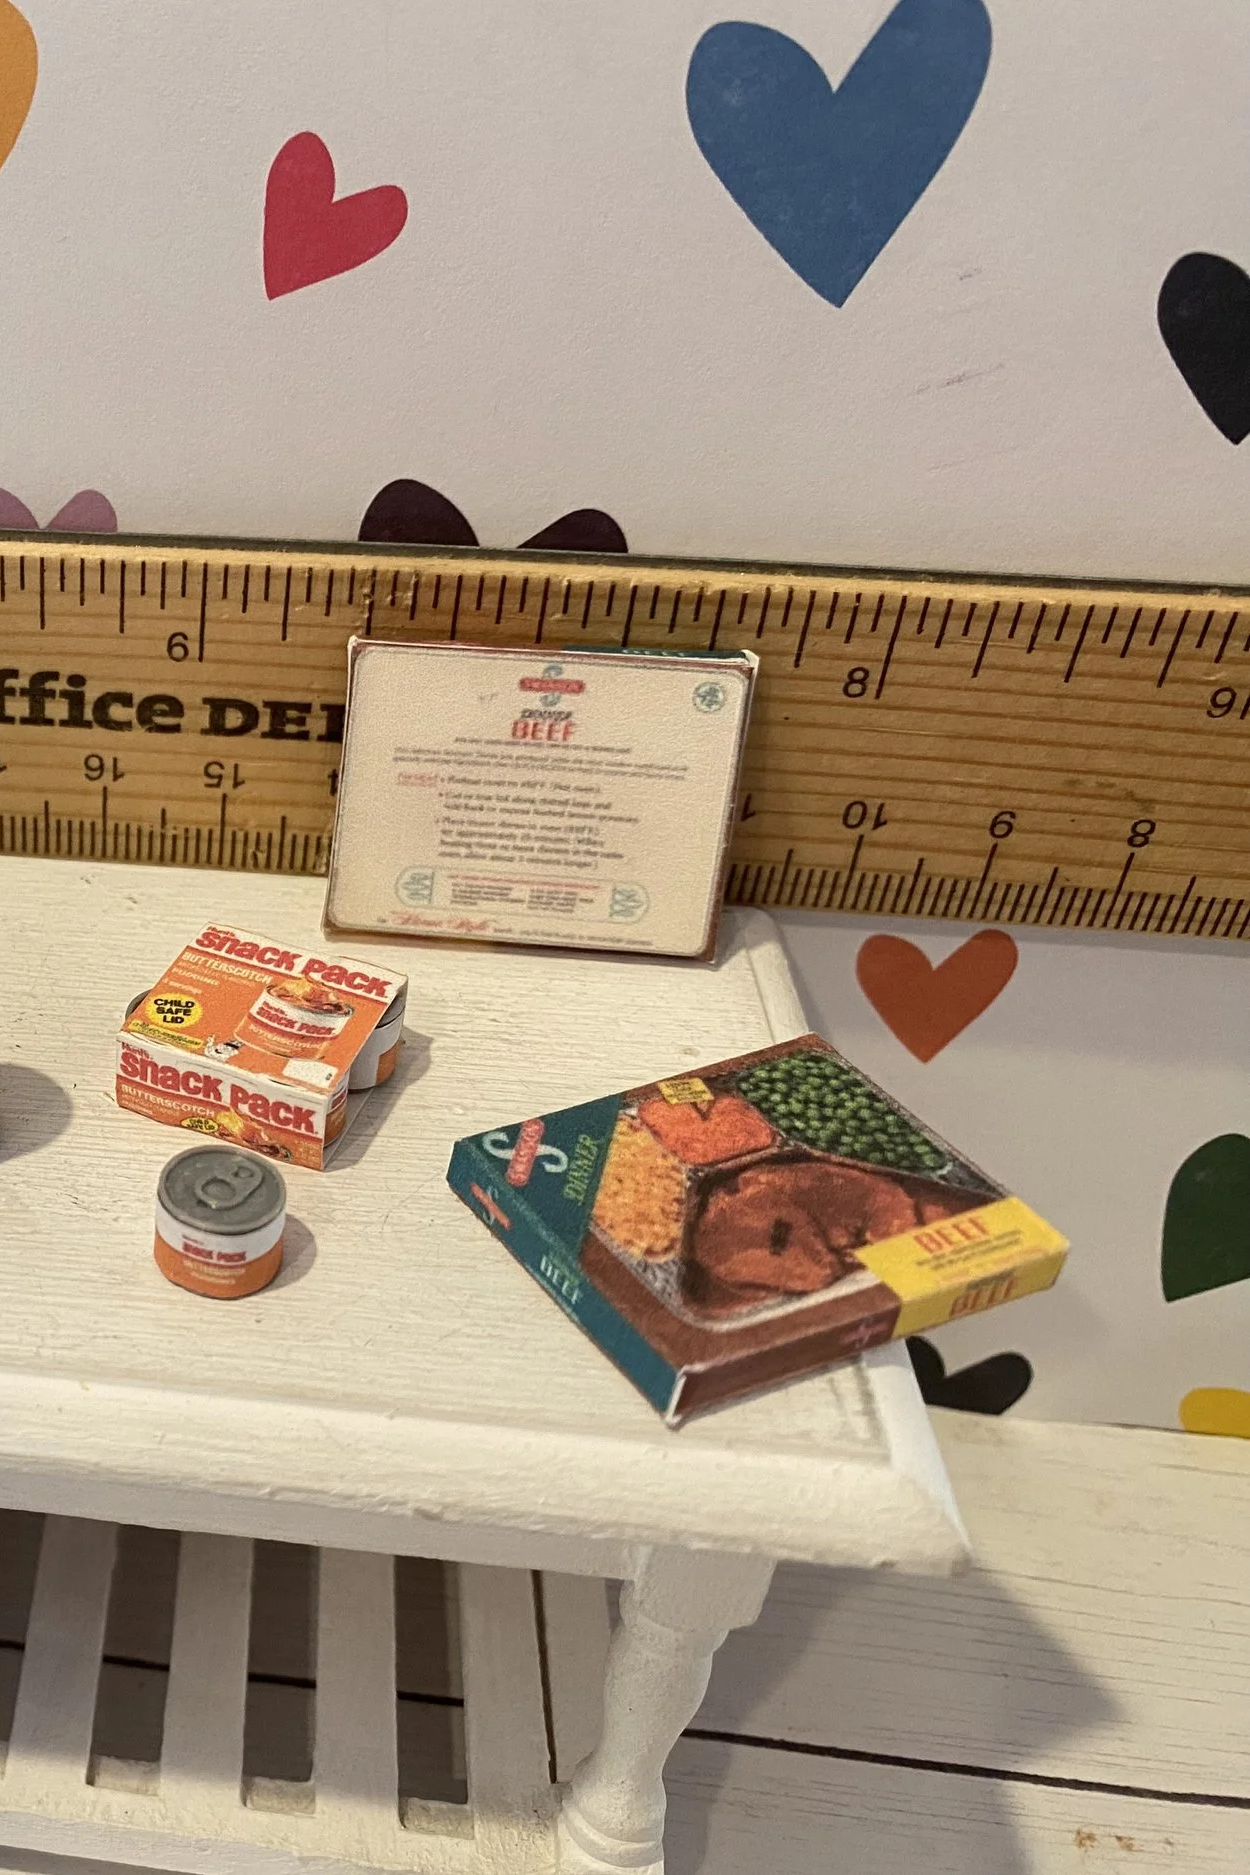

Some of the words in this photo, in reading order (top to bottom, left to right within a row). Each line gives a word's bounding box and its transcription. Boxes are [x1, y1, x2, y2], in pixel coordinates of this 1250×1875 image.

[166, 631, 189, 662] 6
[842, 667, 870, 698] 8
[1206, 686, 1237, 719] 9
[510, 719, 576, 742] BEEF
[83, 753, 126, 783] 16
[202, 760, 246, 790] 15
[841, 800, 889, 830] 10
[988, 809, 1017, 840] 9
[1126, 818, 1157, 849] 8
[181, 951, 275, 984] BUTTERSCOTCH
[153, 998, 196, 1009] CHILD
[156, 1006, 192, 1017] SAFE
[162, 1014, 185, 1025] LID
[121, 1084, 215, 1117] BUTTERSCOTCH
[912, 1215, 991, 1254] BEEF
